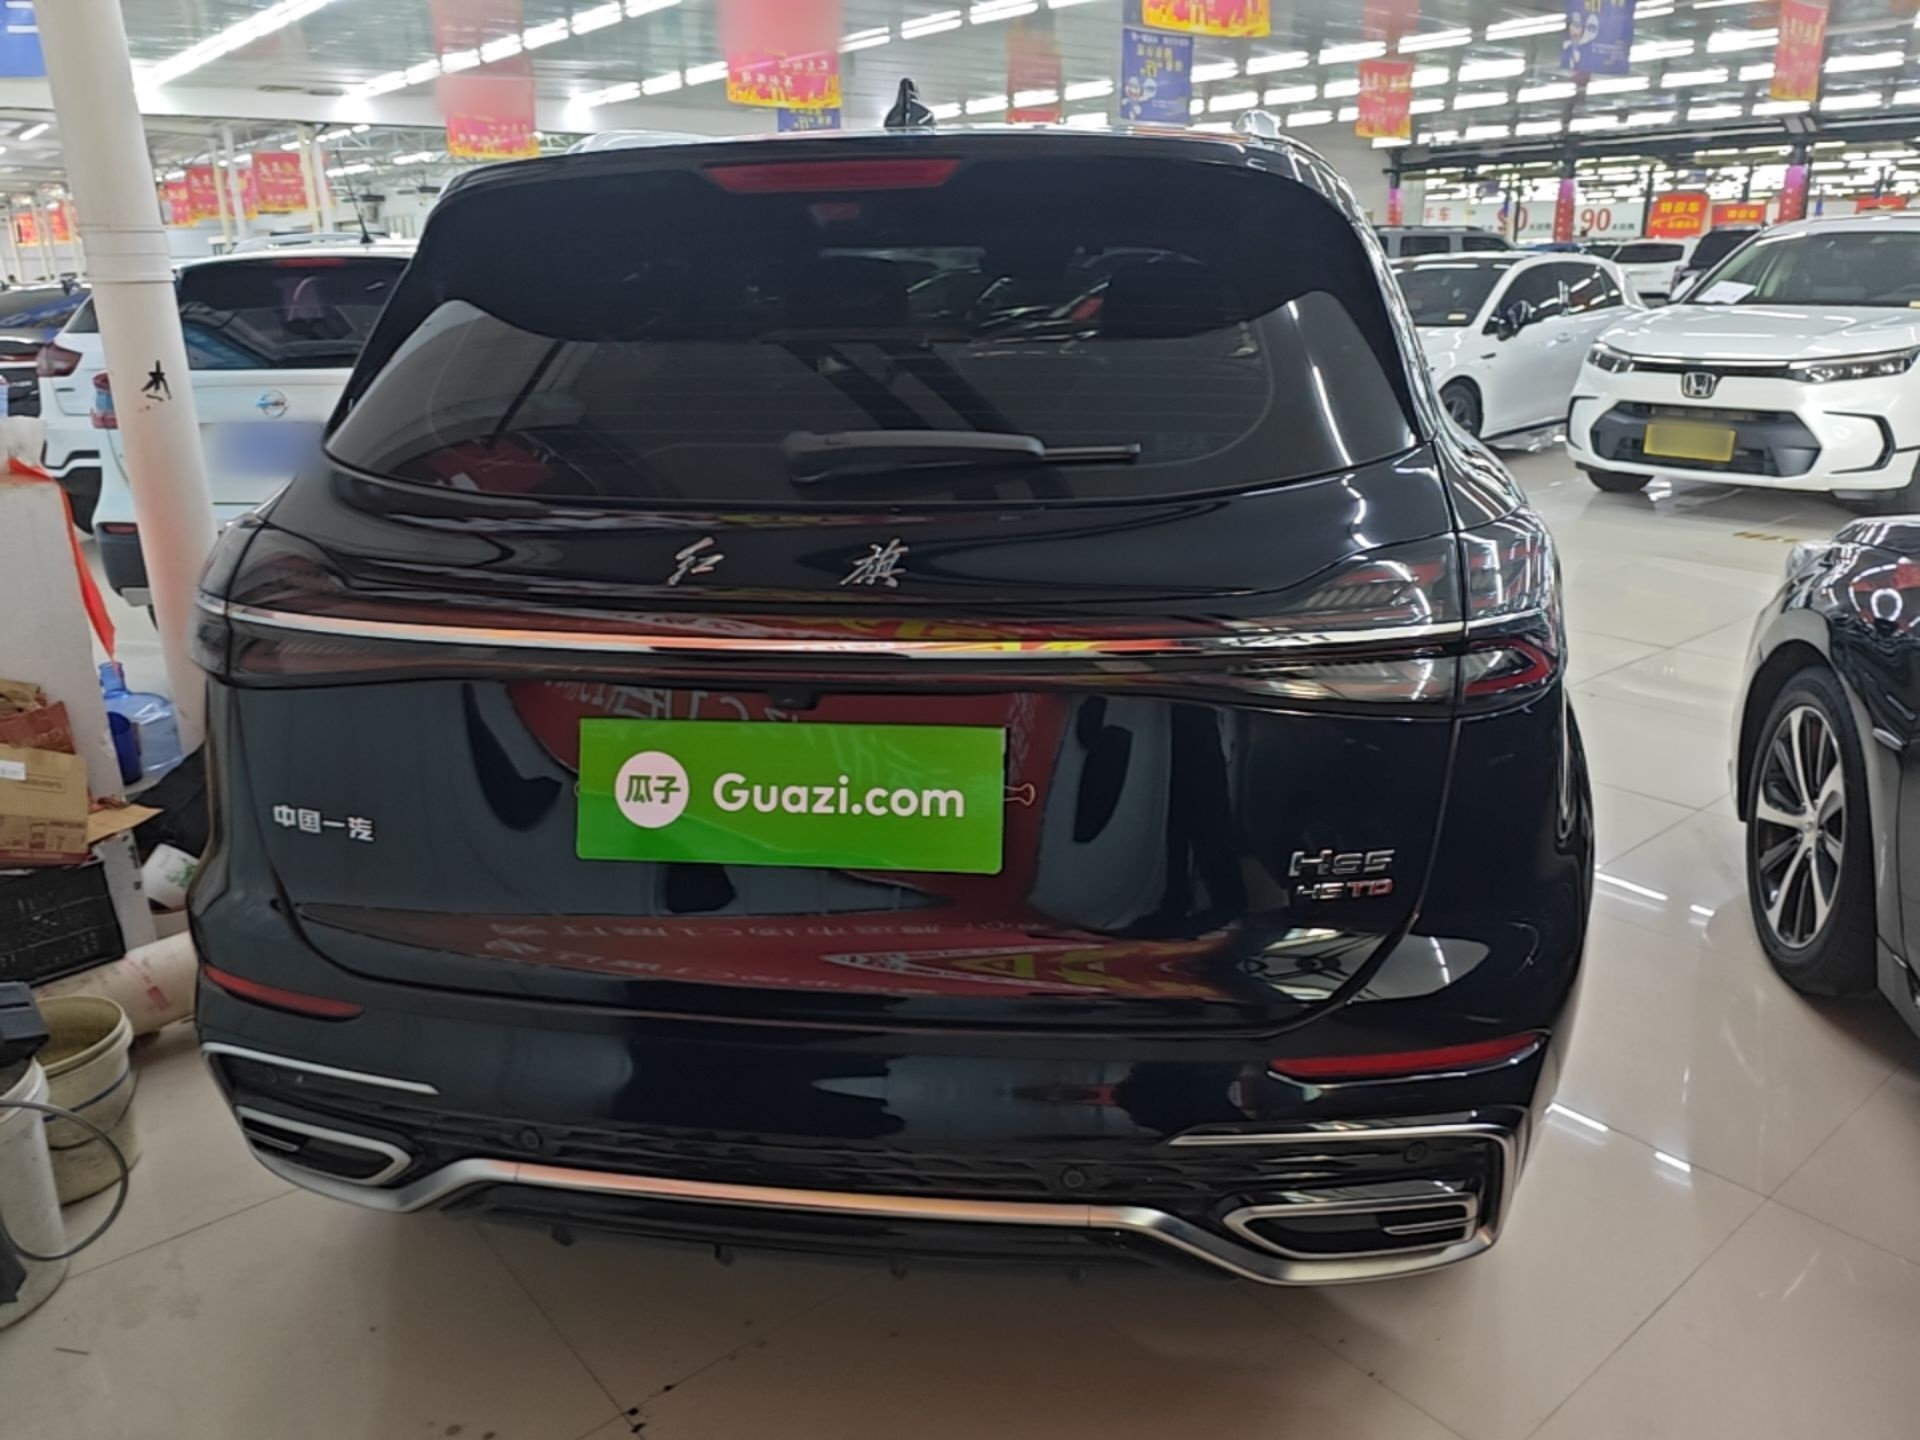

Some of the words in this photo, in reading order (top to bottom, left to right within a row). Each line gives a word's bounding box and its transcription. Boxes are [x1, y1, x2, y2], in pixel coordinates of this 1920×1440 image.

[1580, 207, 1612, 232] 90
[625, 774, 681, 804] 瓜子
[712, 772, 966, 818] Guazi.com
[273, 804, 374, 842] 中国一汽
